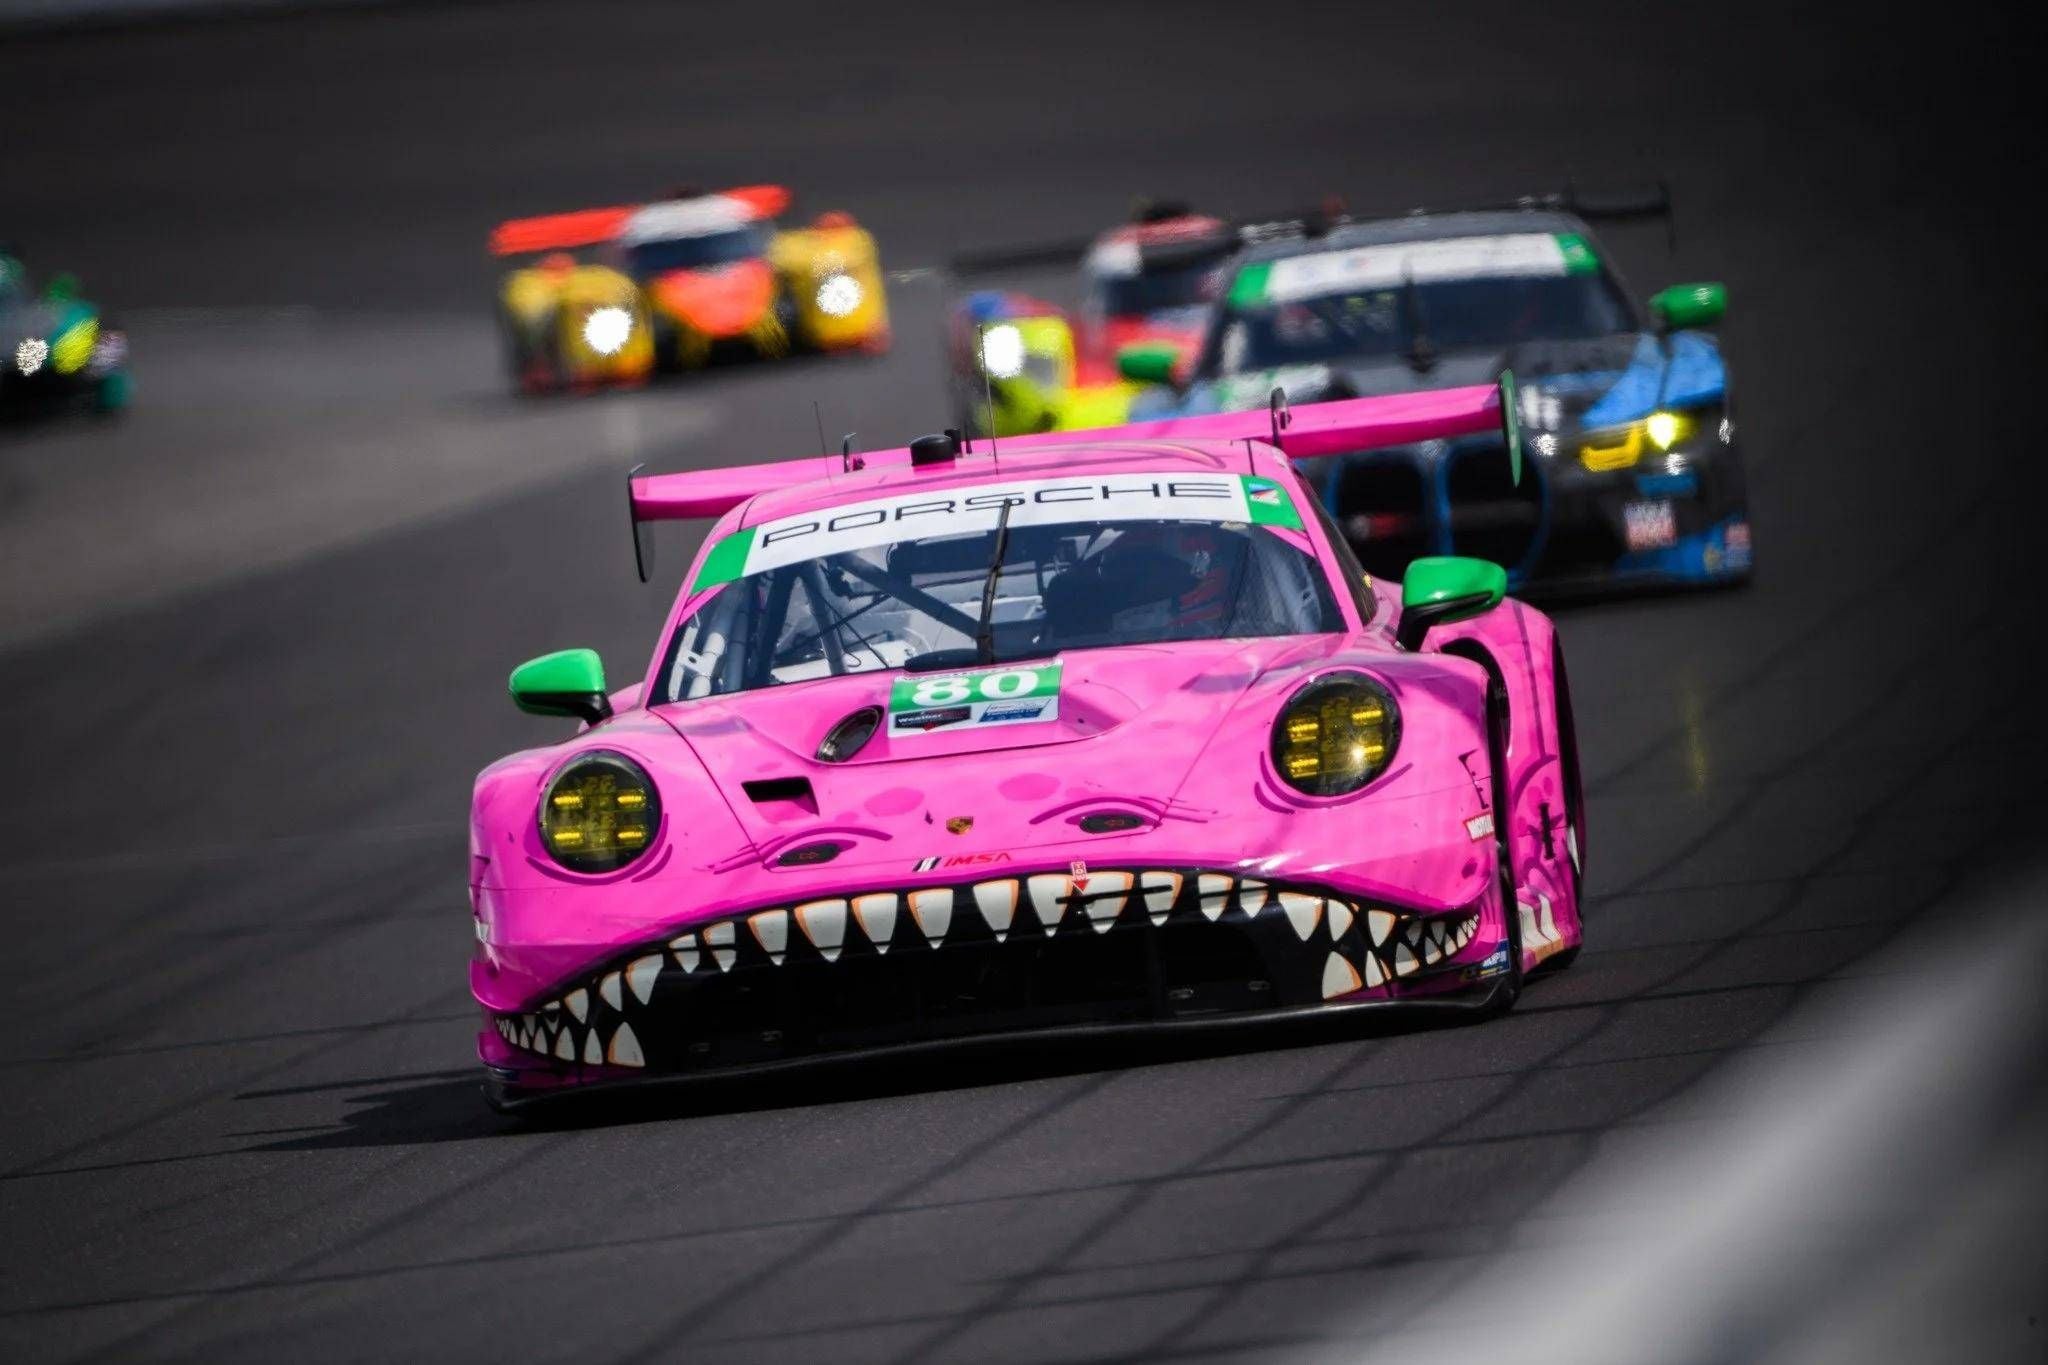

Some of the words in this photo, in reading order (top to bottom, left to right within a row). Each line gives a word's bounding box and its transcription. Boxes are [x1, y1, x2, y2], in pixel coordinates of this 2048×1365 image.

[762, 482, 1232, 548] PORSCHE
[912, 671, 1039, 706] 80
[944, 853, 1011, 867] IMSA
